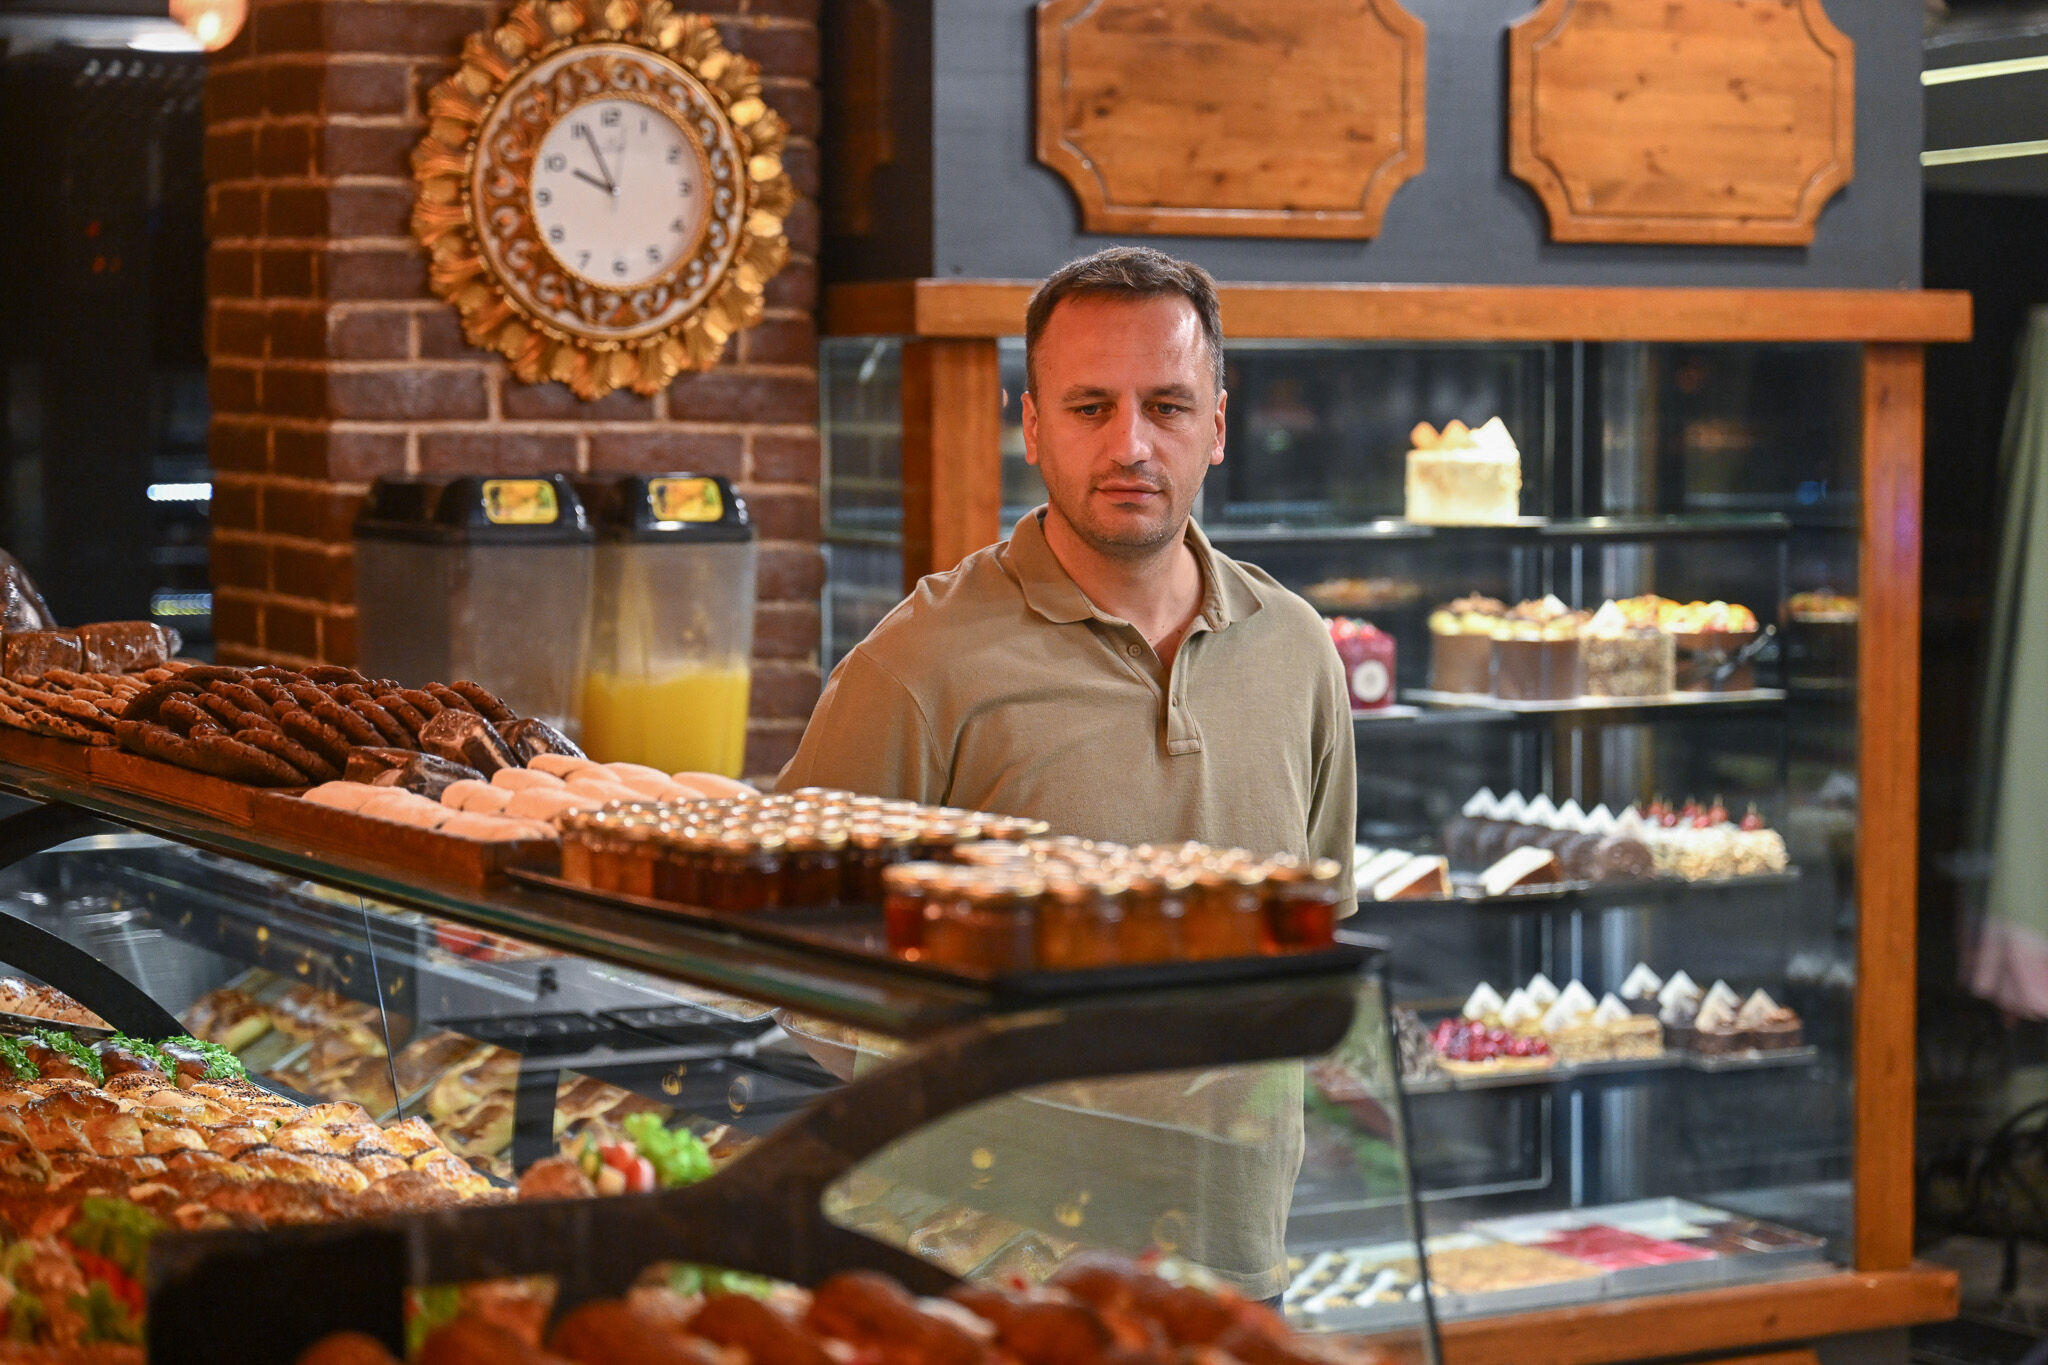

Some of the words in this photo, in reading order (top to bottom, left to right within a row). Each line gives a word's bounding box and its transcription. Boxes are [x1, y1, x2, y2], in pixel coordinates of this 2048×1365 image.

[601, 108, 621, 127] 12
[640, 118, 648, 134] 1
[544, 154, 566, 172] 10
[668, 146, 680, 163] 2
[537, 188, 552, 206] 9
[680, 180, 691, 197] 3
[550, 225, 565, 242] 8
[578, 250, 591, 268] 7
[648, 245, 661, 263] 5
[613, 258, 627, 275] 6
